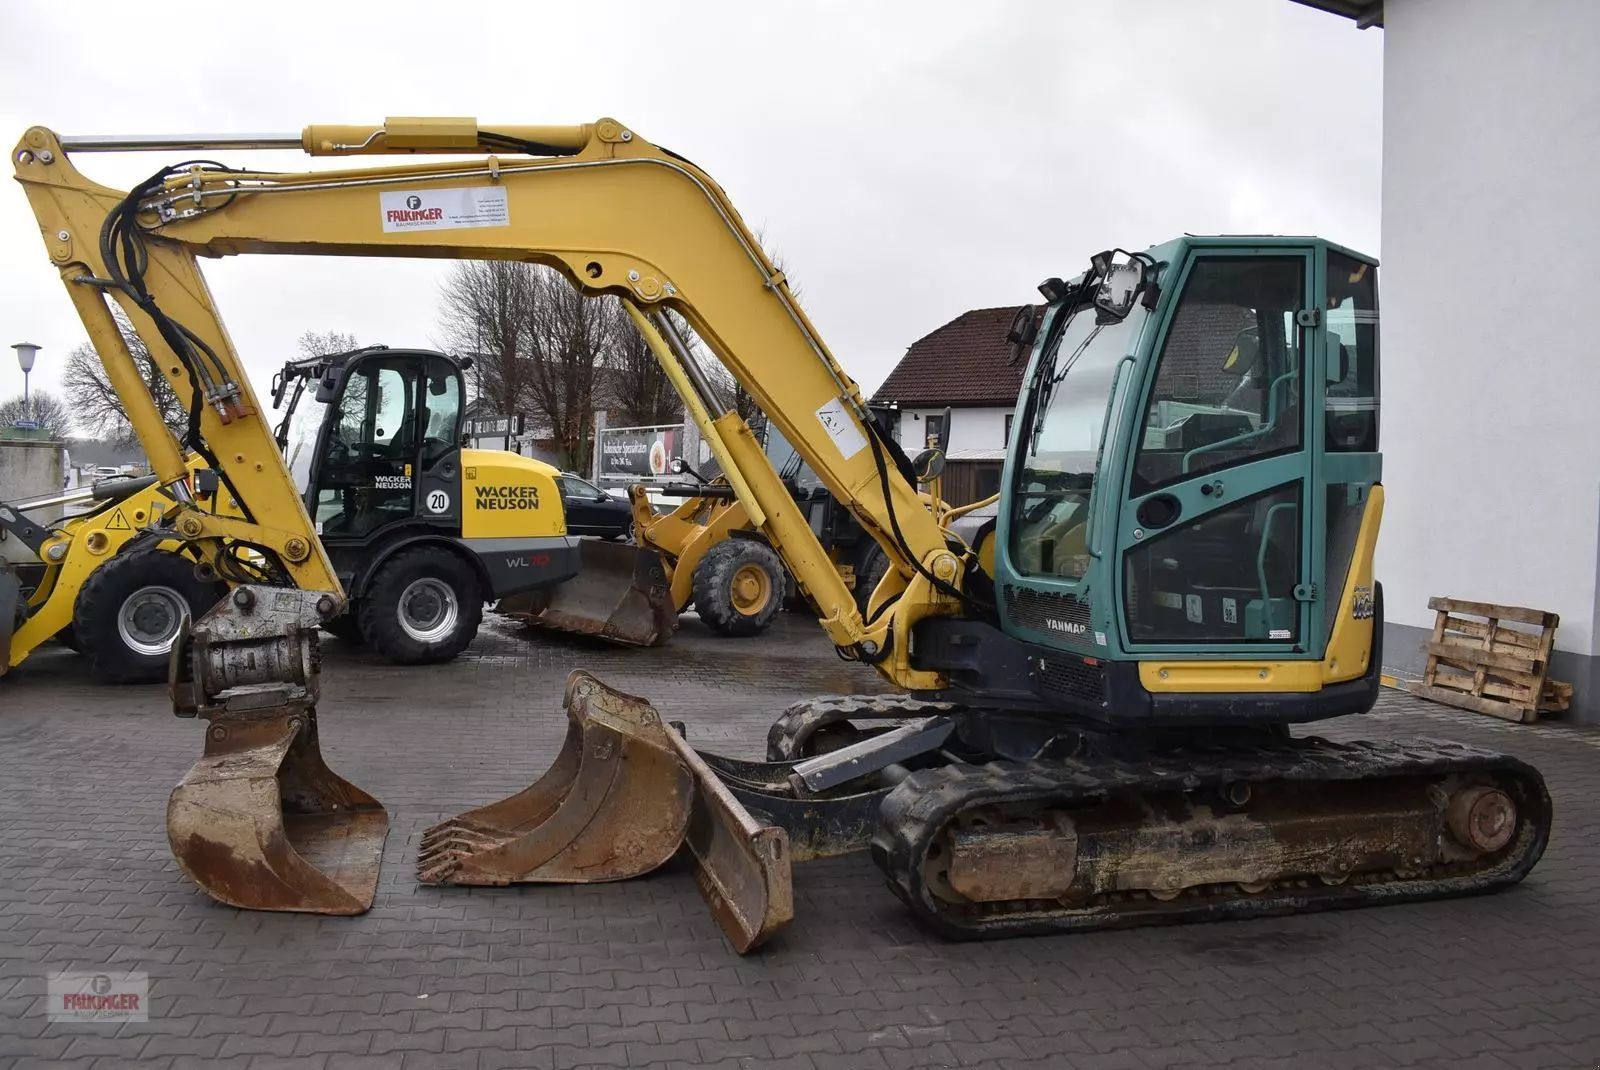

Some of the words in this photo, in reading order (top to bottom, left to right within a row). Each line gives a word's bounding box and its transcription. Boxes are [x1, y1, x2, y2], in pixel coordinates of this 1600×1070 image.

[387, 208, 443, 222] FALKINGER
[375, 475, 412, 483] WACKER
[475, 486, 539, 498] WACKER
[431, 494, 445, 509] 20
[476, 498, 539, 510] NEUSON
[506, 557, 529, 568] WL
